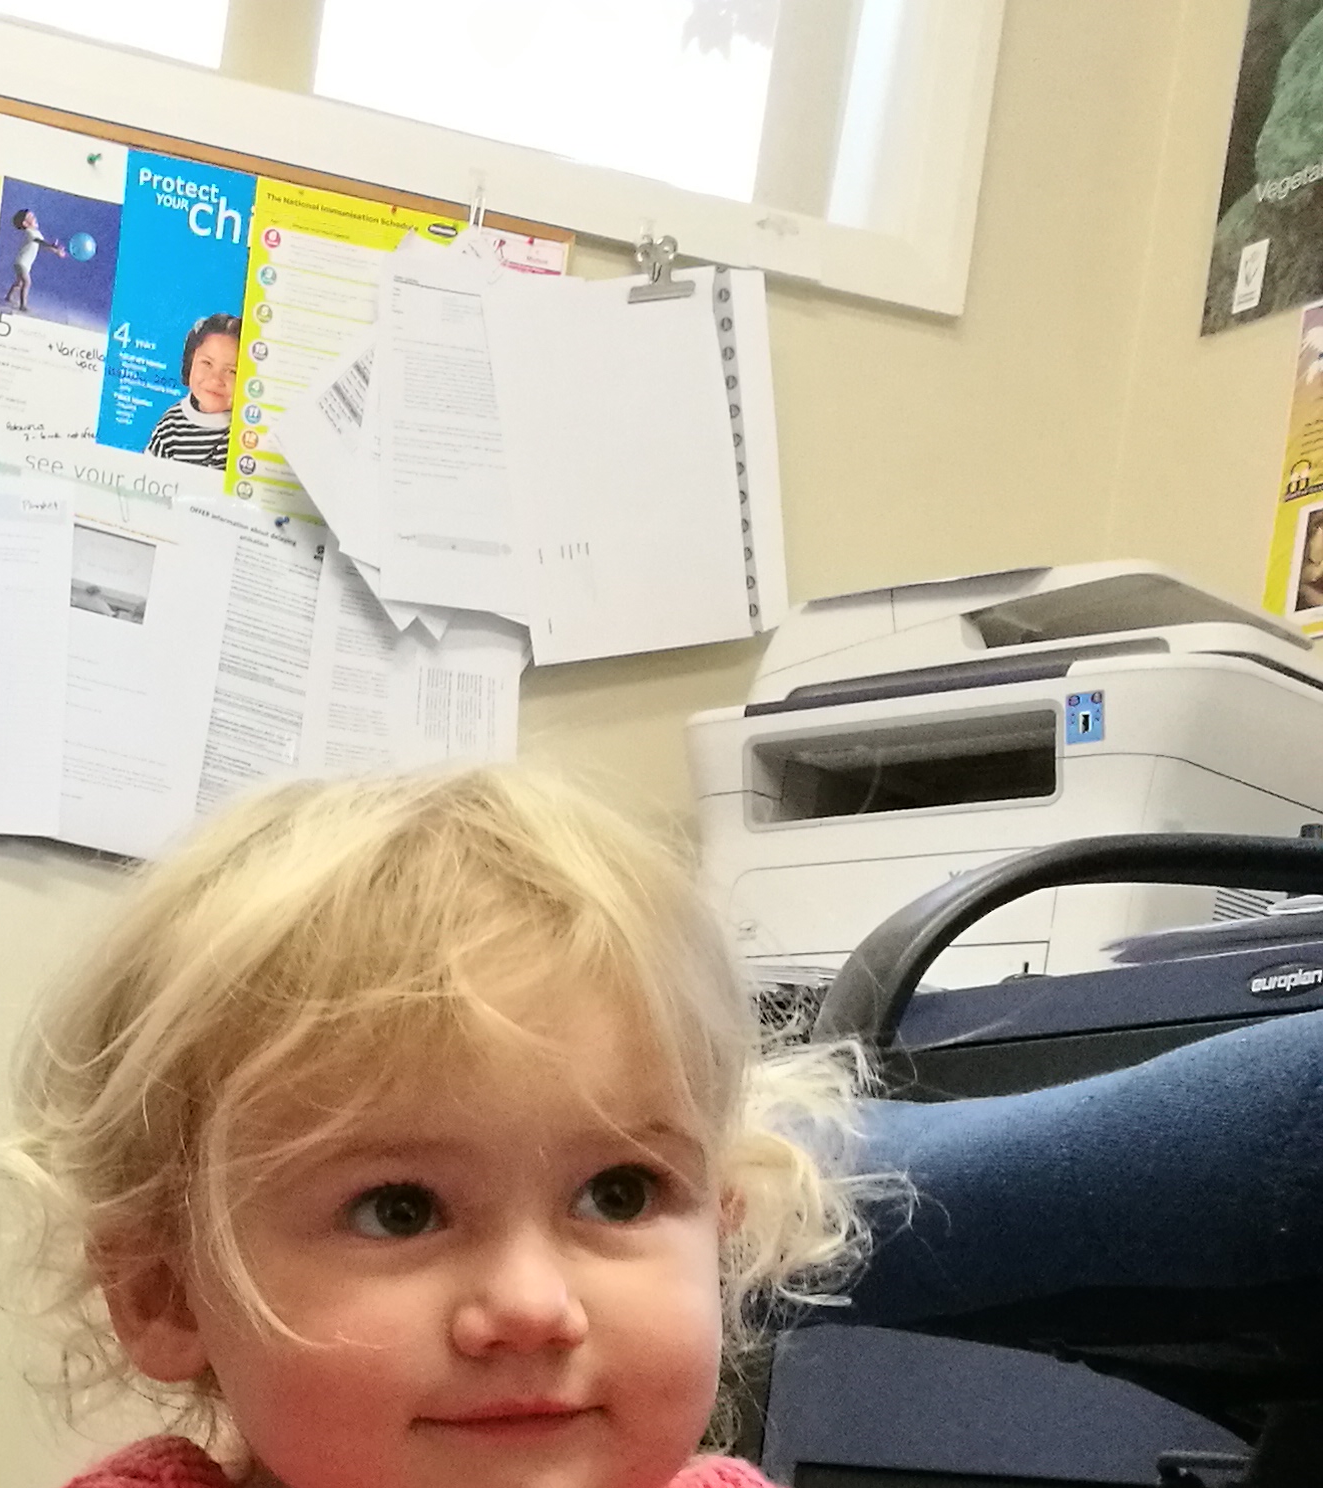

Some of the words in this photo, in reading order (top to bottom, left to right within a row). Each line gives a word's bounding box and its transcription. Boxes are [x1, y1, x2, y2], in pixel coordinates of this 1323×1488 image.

[138, 166, 221, 204] Protect
[155, 192, 190, 212] YOUR
[266, 191, 283, 204] The
[283, 196, 320, 212] National
[320, 203, 379, 224] Immunisation
[112, 320, 133, 349] 4
[24, 452, 65, 475] see
[211, 512, 250, 534] information
[249, 525, 269, 538] about
[1249, 967, 1323, 994] europlan
